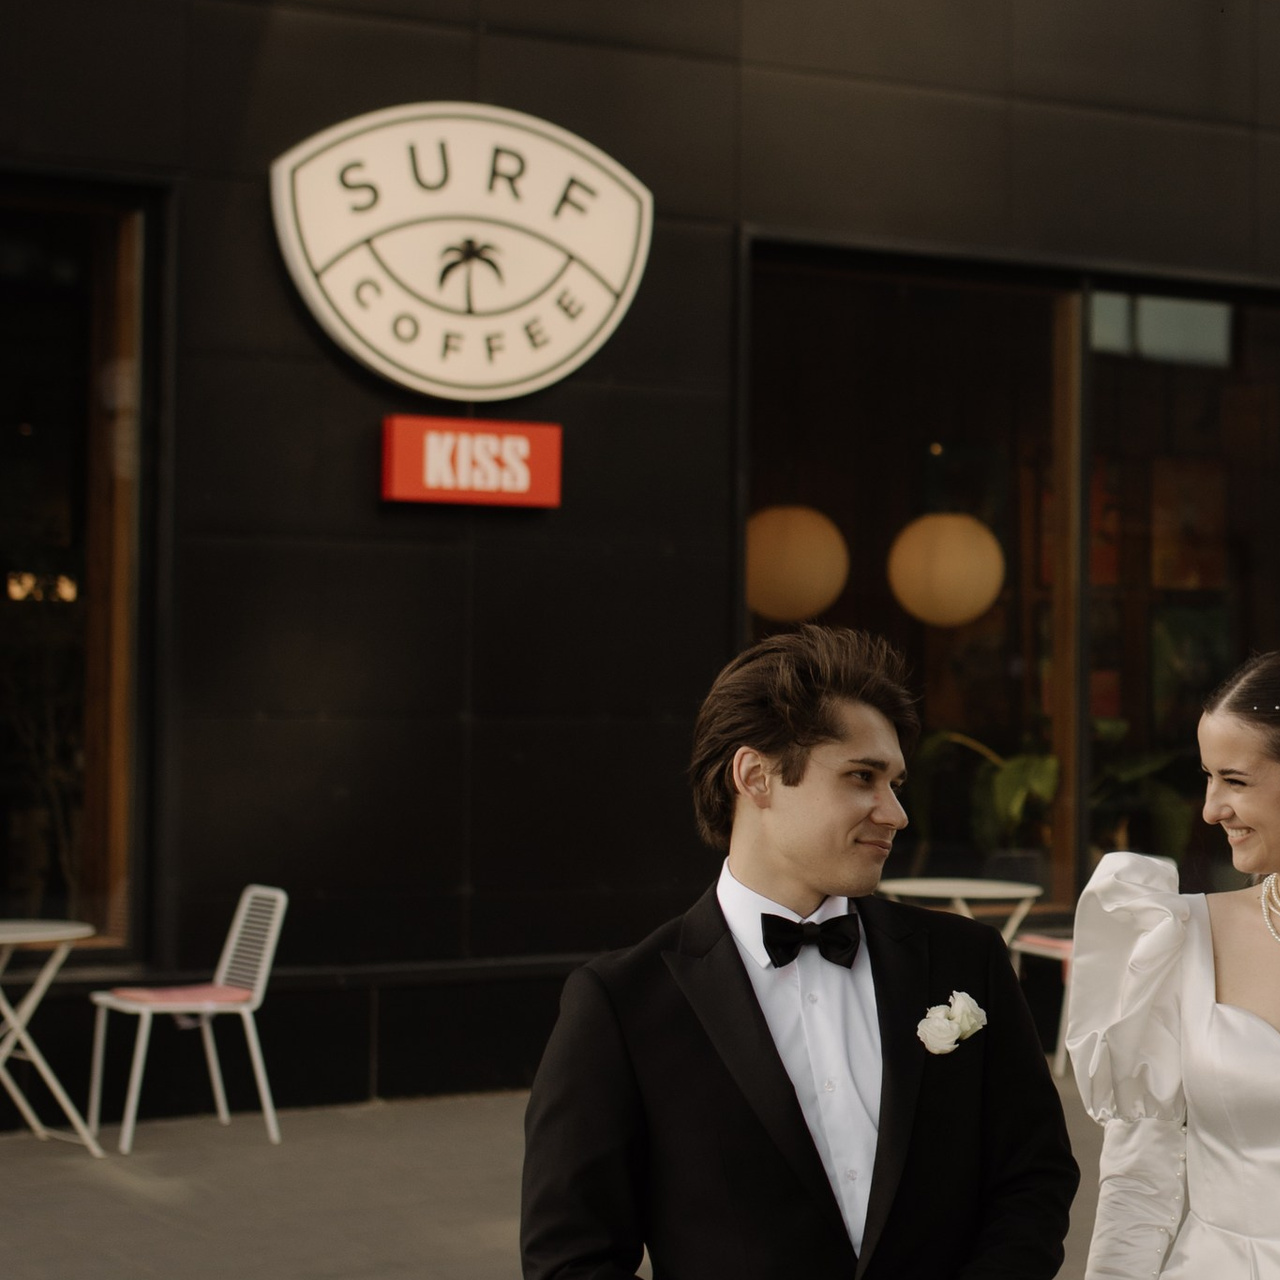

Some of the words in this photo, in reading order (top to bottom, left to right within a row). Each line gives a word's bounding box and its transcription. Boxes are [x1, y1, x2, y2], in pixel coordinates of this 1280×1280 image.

[339, 138, 597, 220] SURF
[353, 278, 585, 364] COFFEE
[423, 430, 530, 493] KISS
